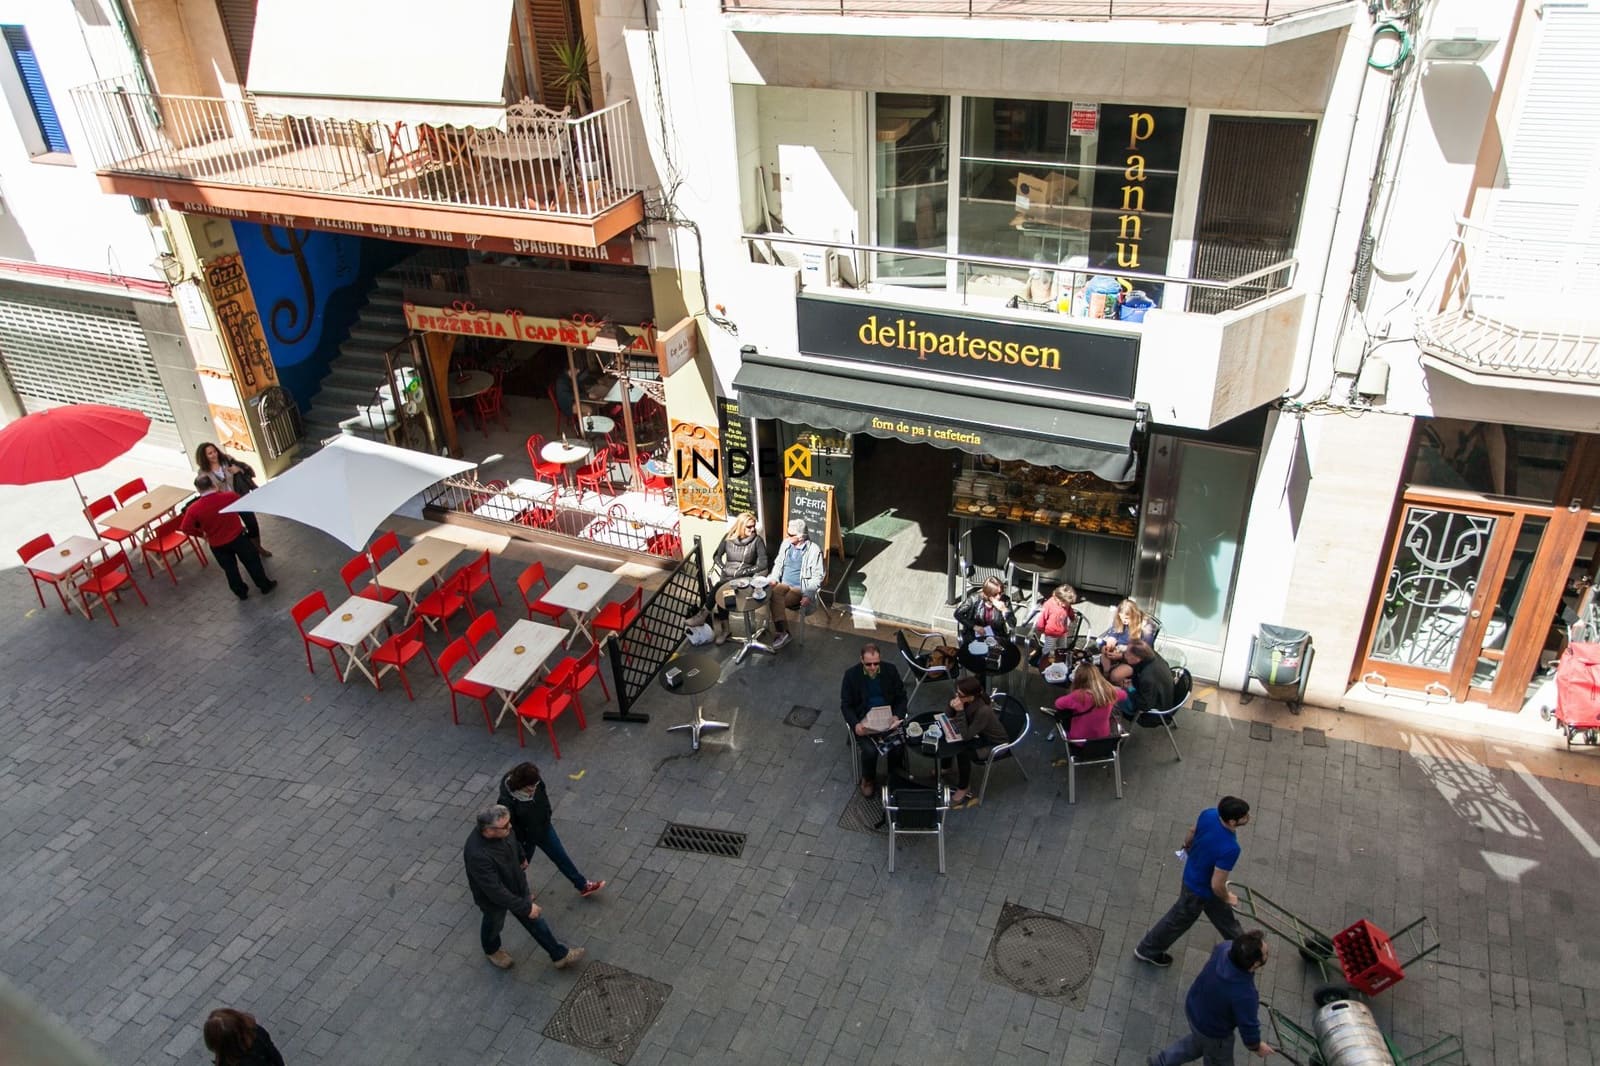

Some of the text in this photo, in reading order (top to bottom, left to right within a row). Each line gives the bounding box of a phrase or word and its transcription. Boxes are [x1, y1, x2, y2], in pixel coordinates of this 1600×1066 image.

[513, 238, 609, 260] SPAGUETTERIA
[211, 264, 243, 285] PIZZA
[214, 279, 247, 300] PASTA
[219, 301, 240, 317] PER
[416, 315, 507, 337] PIZZERIA
[525, 325, 557, 341] CAP
[559, 327, 579, 344] DE
[858, 315, 1061, 371] delipatessen
[896, 421, 909, 433] de
[911, 426, 924, 437] pa
[927, 425, 932, 437] i
[934, 428, 981, 445] cafeteria
[795, 497, 827, 511] OFERTA
[1568, 498, 1582, 512] 5
